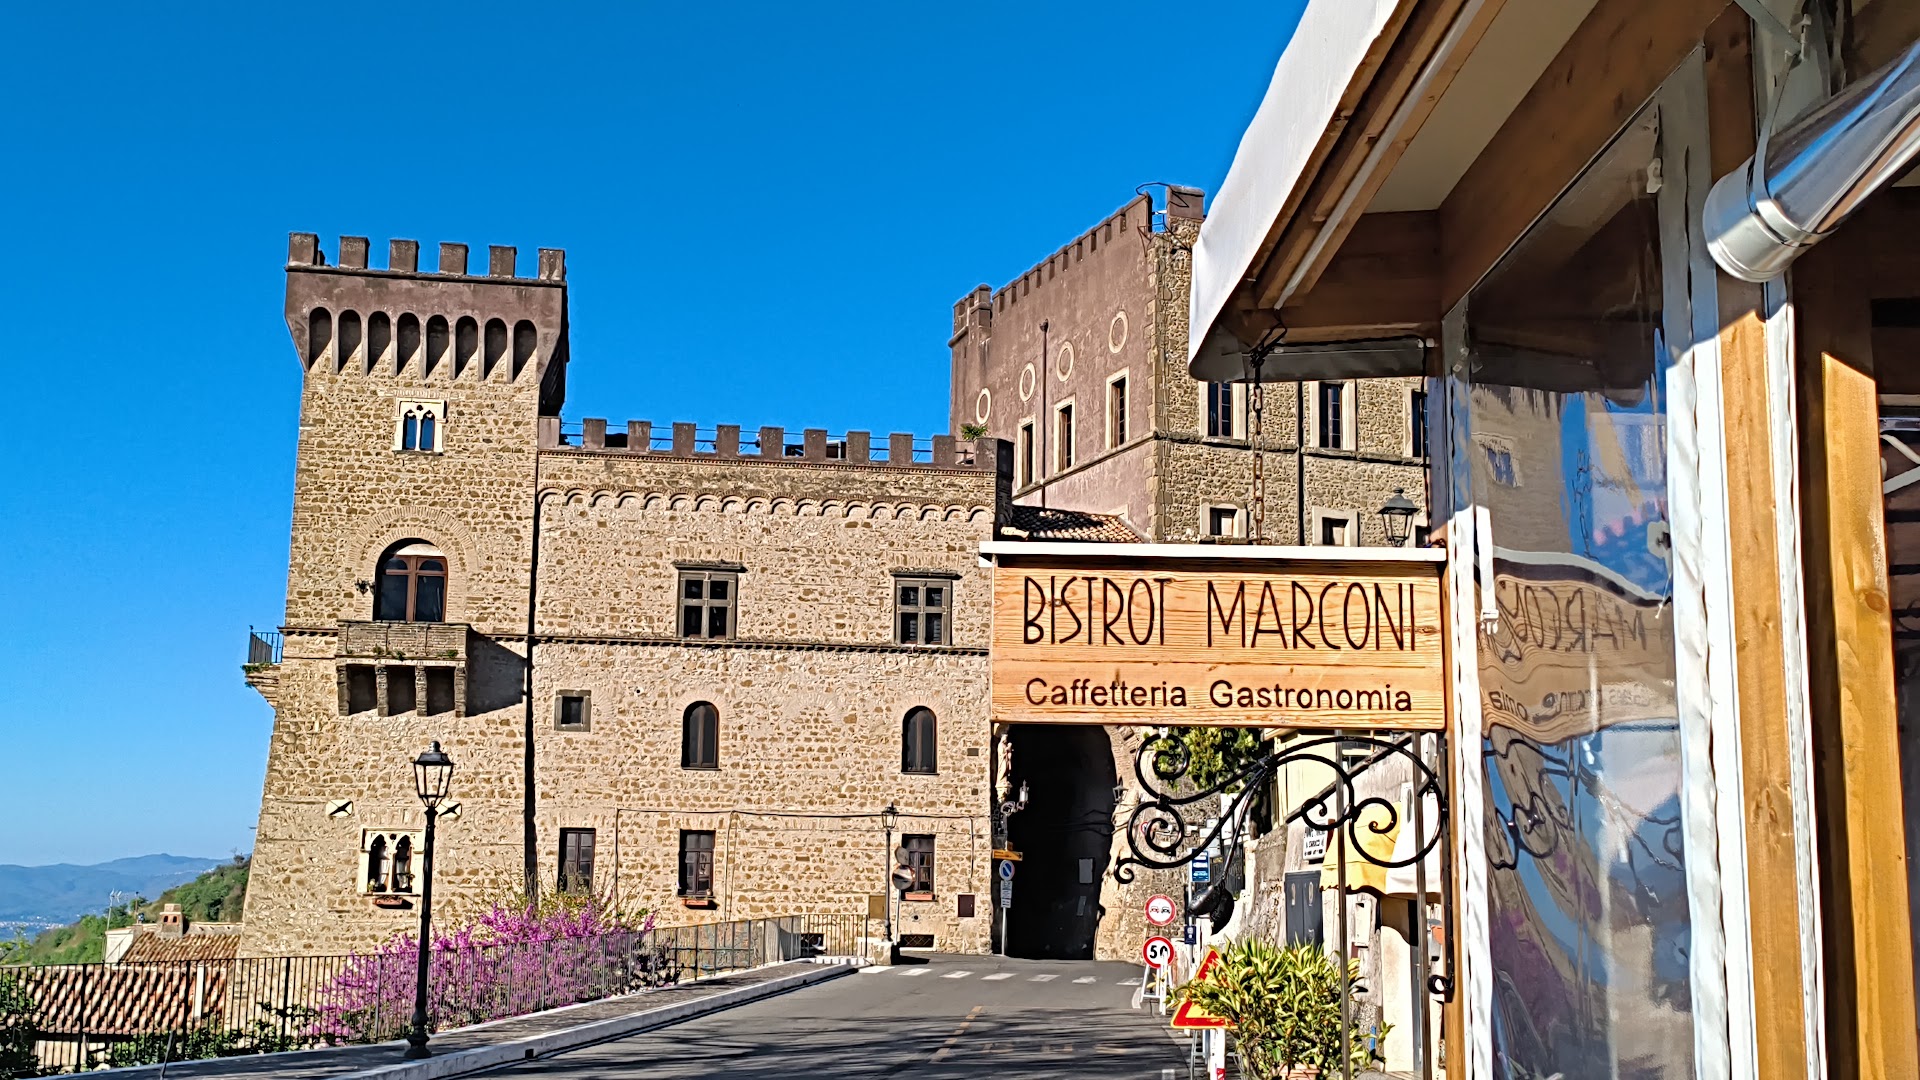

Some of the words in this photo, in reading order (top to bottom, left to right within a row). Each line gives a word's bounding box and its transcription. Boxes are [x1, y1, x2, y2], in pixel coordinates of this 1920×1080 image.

[1023, 575, 1173, 646] BISTROT
[1207, 580, 1416, 652] MARCONI
[1025, 677, 1188, 707] Caffetteria
[1209, 679, 1413, 712] Gastronomia
